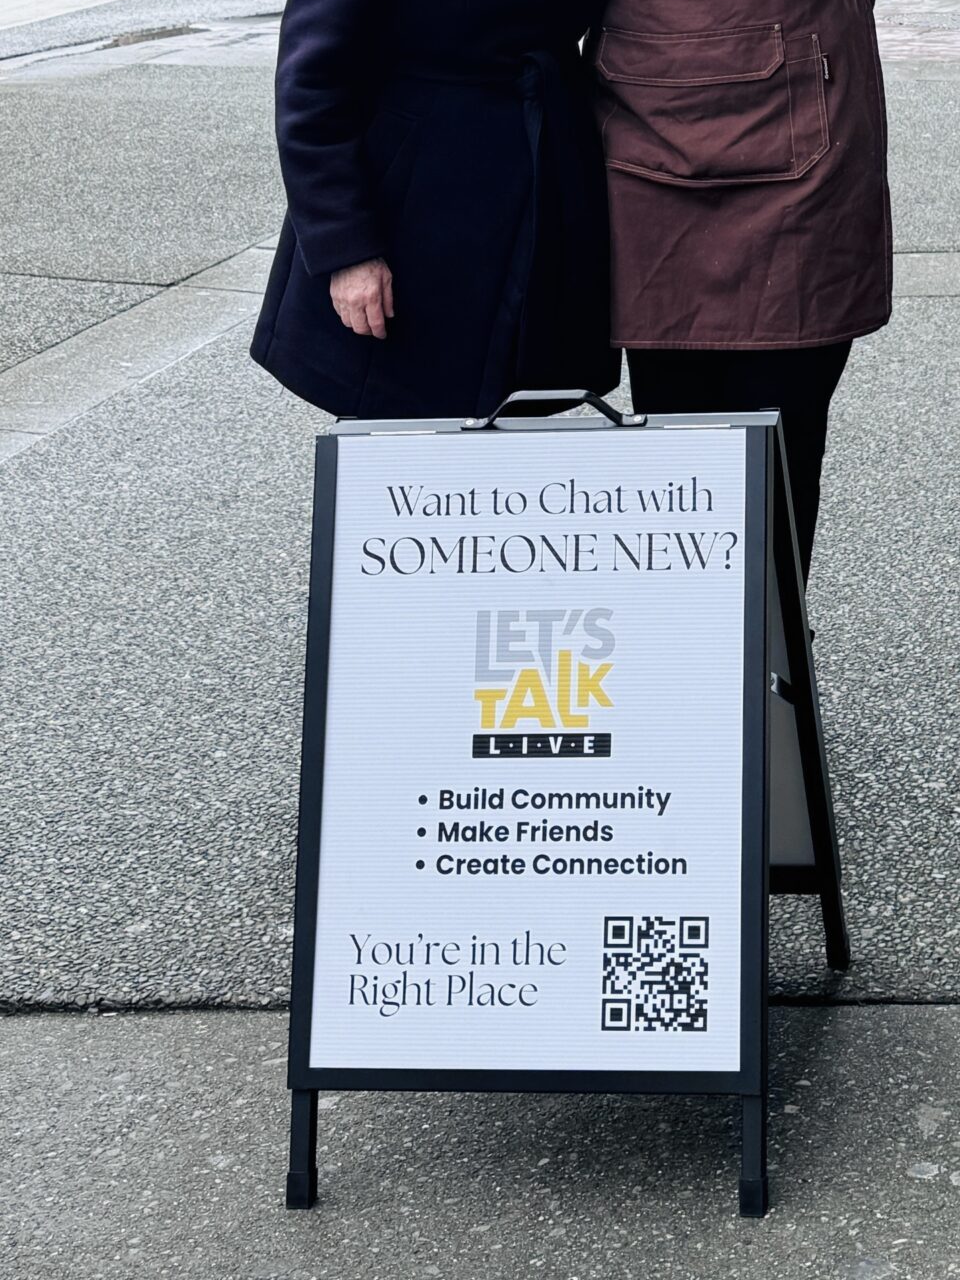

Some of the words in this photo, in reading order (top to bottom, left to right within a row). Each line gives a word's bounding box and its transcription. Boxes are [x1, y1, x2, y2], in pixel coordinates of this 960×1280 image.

[386, 485, 481, 517] Want
[491, 486, 527, 516] to
[539, 478, 629, 515] Chat
[637, 476, 714, 513] with
[361, 534, 598, 576] SOMEONE
[612, 531, 738, 571] NEW?
[474, 607, 616, 687] LET'S
[439, 787, 504, 810] Build
[511, 786, 672, 816] Community
[437, 821, 510, 842] Make
[516, 819, 614, 842] Friends
[436, 854, 526, 875] Create
[532, 851, 687, 875] Connection
[349, 933, 461, 965] You're
[470, 935, 500, 965] in
[511, 930, 567, 966] the
[349, 970, 437, 1017] Right
[446, 970, 539, 1007] Place
